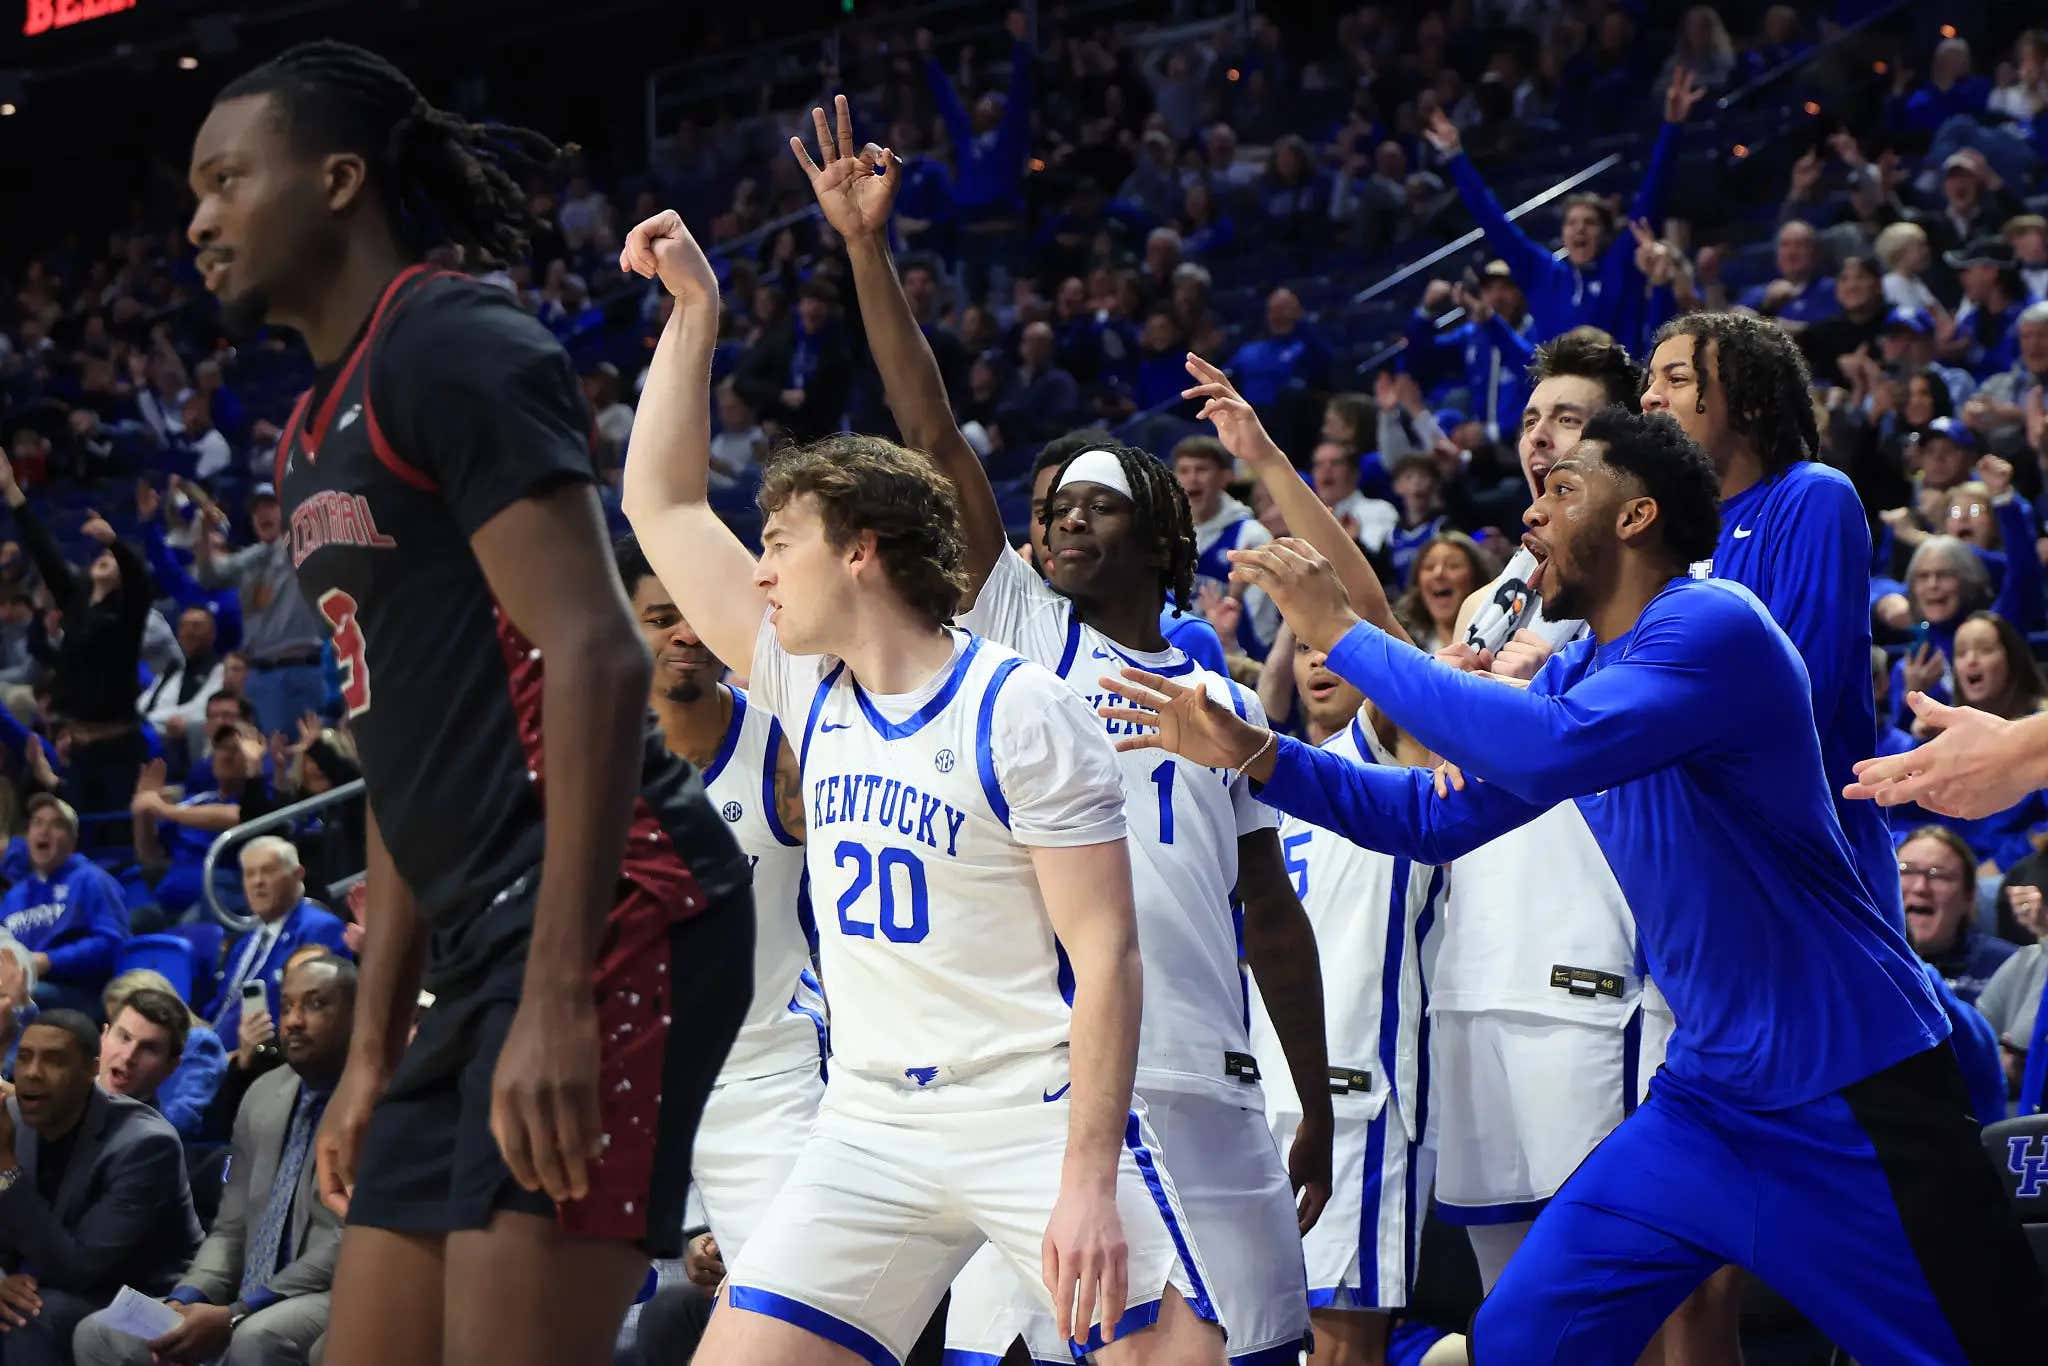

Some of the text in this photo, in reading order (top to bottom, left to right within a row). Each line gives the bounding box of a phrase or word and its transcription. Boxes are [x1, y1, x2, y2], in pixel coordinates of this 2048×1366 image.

[291, 489, 398, 568] CENTRAL
[935, 749, 955, 772] SEC
[723, 801, 743, 822] SEC
[814, 774, 966, 857] KENTUCKY
[1151, 759, 1176, 845] 1
[834, 840, 930, 943] 20
[1601, 979, 1614, 990] 48
